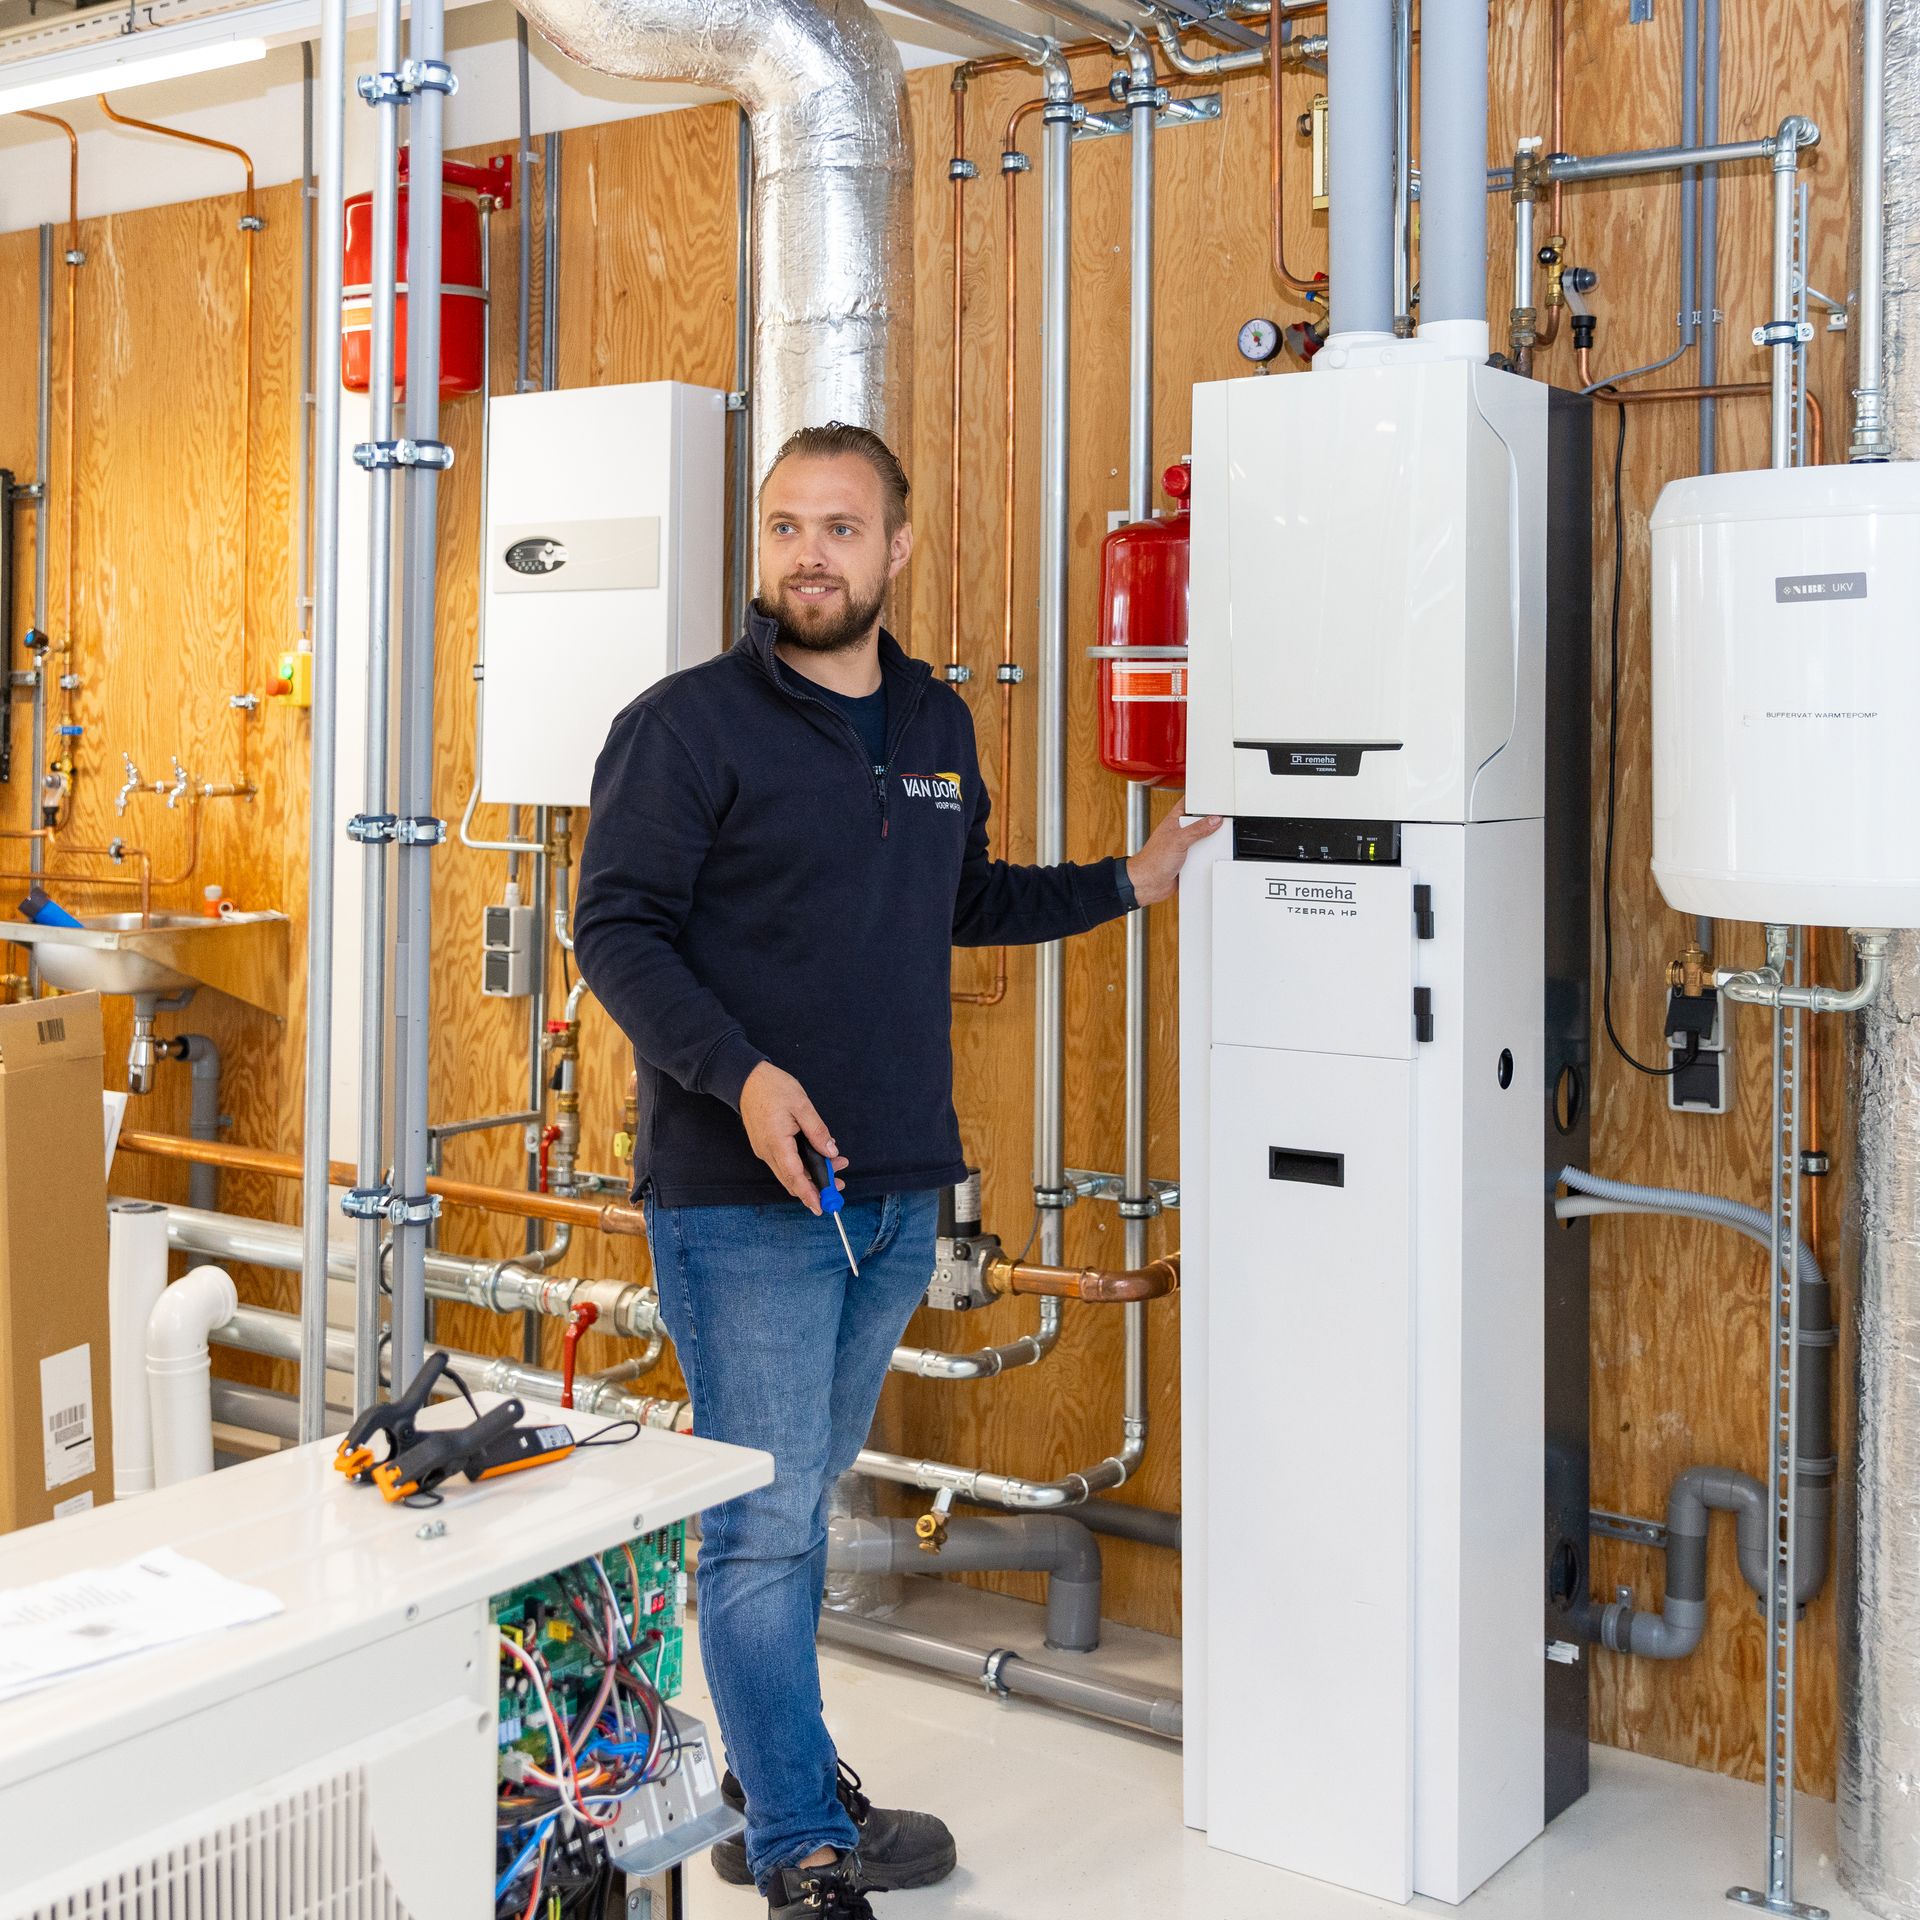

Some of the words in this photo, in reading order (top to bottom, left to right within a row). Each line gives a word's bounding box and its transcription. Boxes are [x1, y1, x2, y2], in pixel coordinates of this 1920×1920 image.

[1792, 583, 1826, 594] NIBE
[1832, 582, 1854, 593] UKV
[1766, 711, 1813, 719] BUFFERVAT
[1814, 711, 1879, 719] WARMTEPOMP
[1305, 756, 1335, 764] remeha
[902, 778, 932, 798] VAN
[1295, 885, 1353, 900] remeha
[1287, 906, 1335, 916] TZERRA
[1341, 909, 1357, 917] HP
